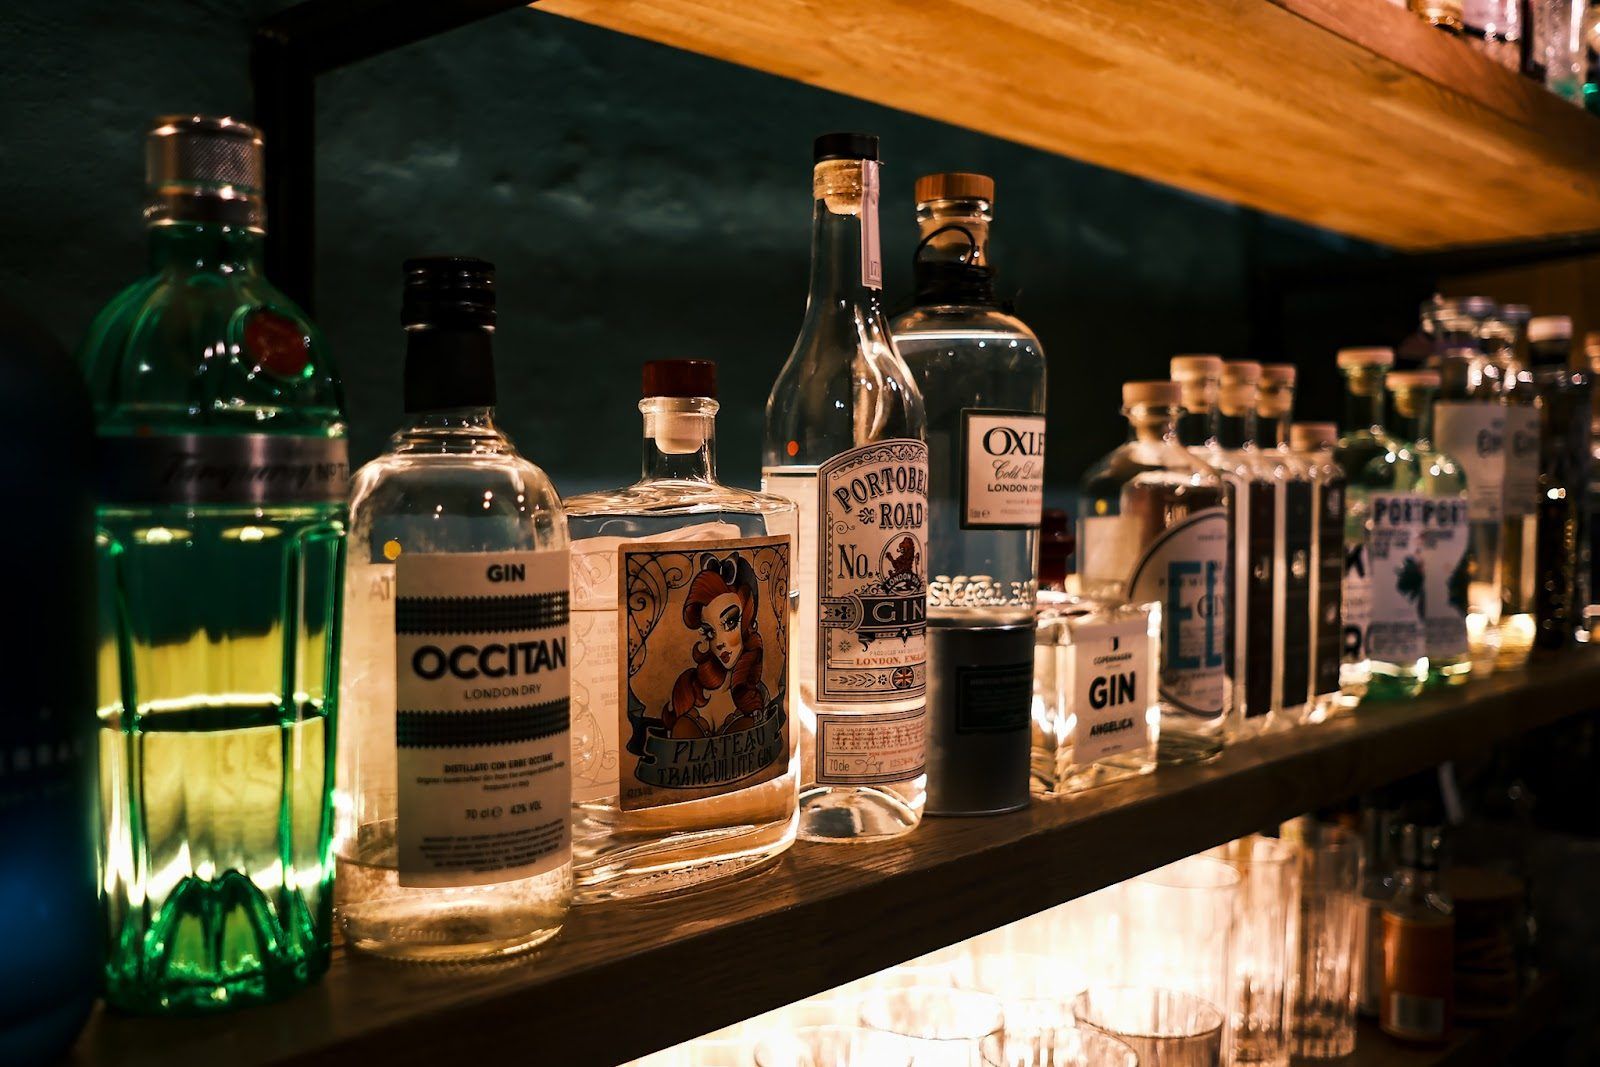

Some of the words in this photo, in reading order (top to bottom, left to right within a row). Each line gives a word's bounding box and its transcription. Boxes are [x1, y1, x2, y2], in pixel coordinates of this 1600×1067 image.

[992, 459, 1021, 480] Cold
[987, 484, 1027, 493] LONDON
[879, 502, 923, 529] ROAD
[838, 544, 873, 579] No.
[487, 564, 526, 582] GIN
[885, 572, 911, 589] LONDON
[872, 599, 924, 622] GIN
[412, 637, 566, 680] OCCITAN
[856, 656, 901, 666] LONDON,
[464, 686, 519, 700] LONDON
[521, 684, 542, 696] DRY
[1089, 671, 1135, 710] GIN
[1090, 718, 1134, 736] ANGELICA
[673, 726, 765, 763] PLATEAU
